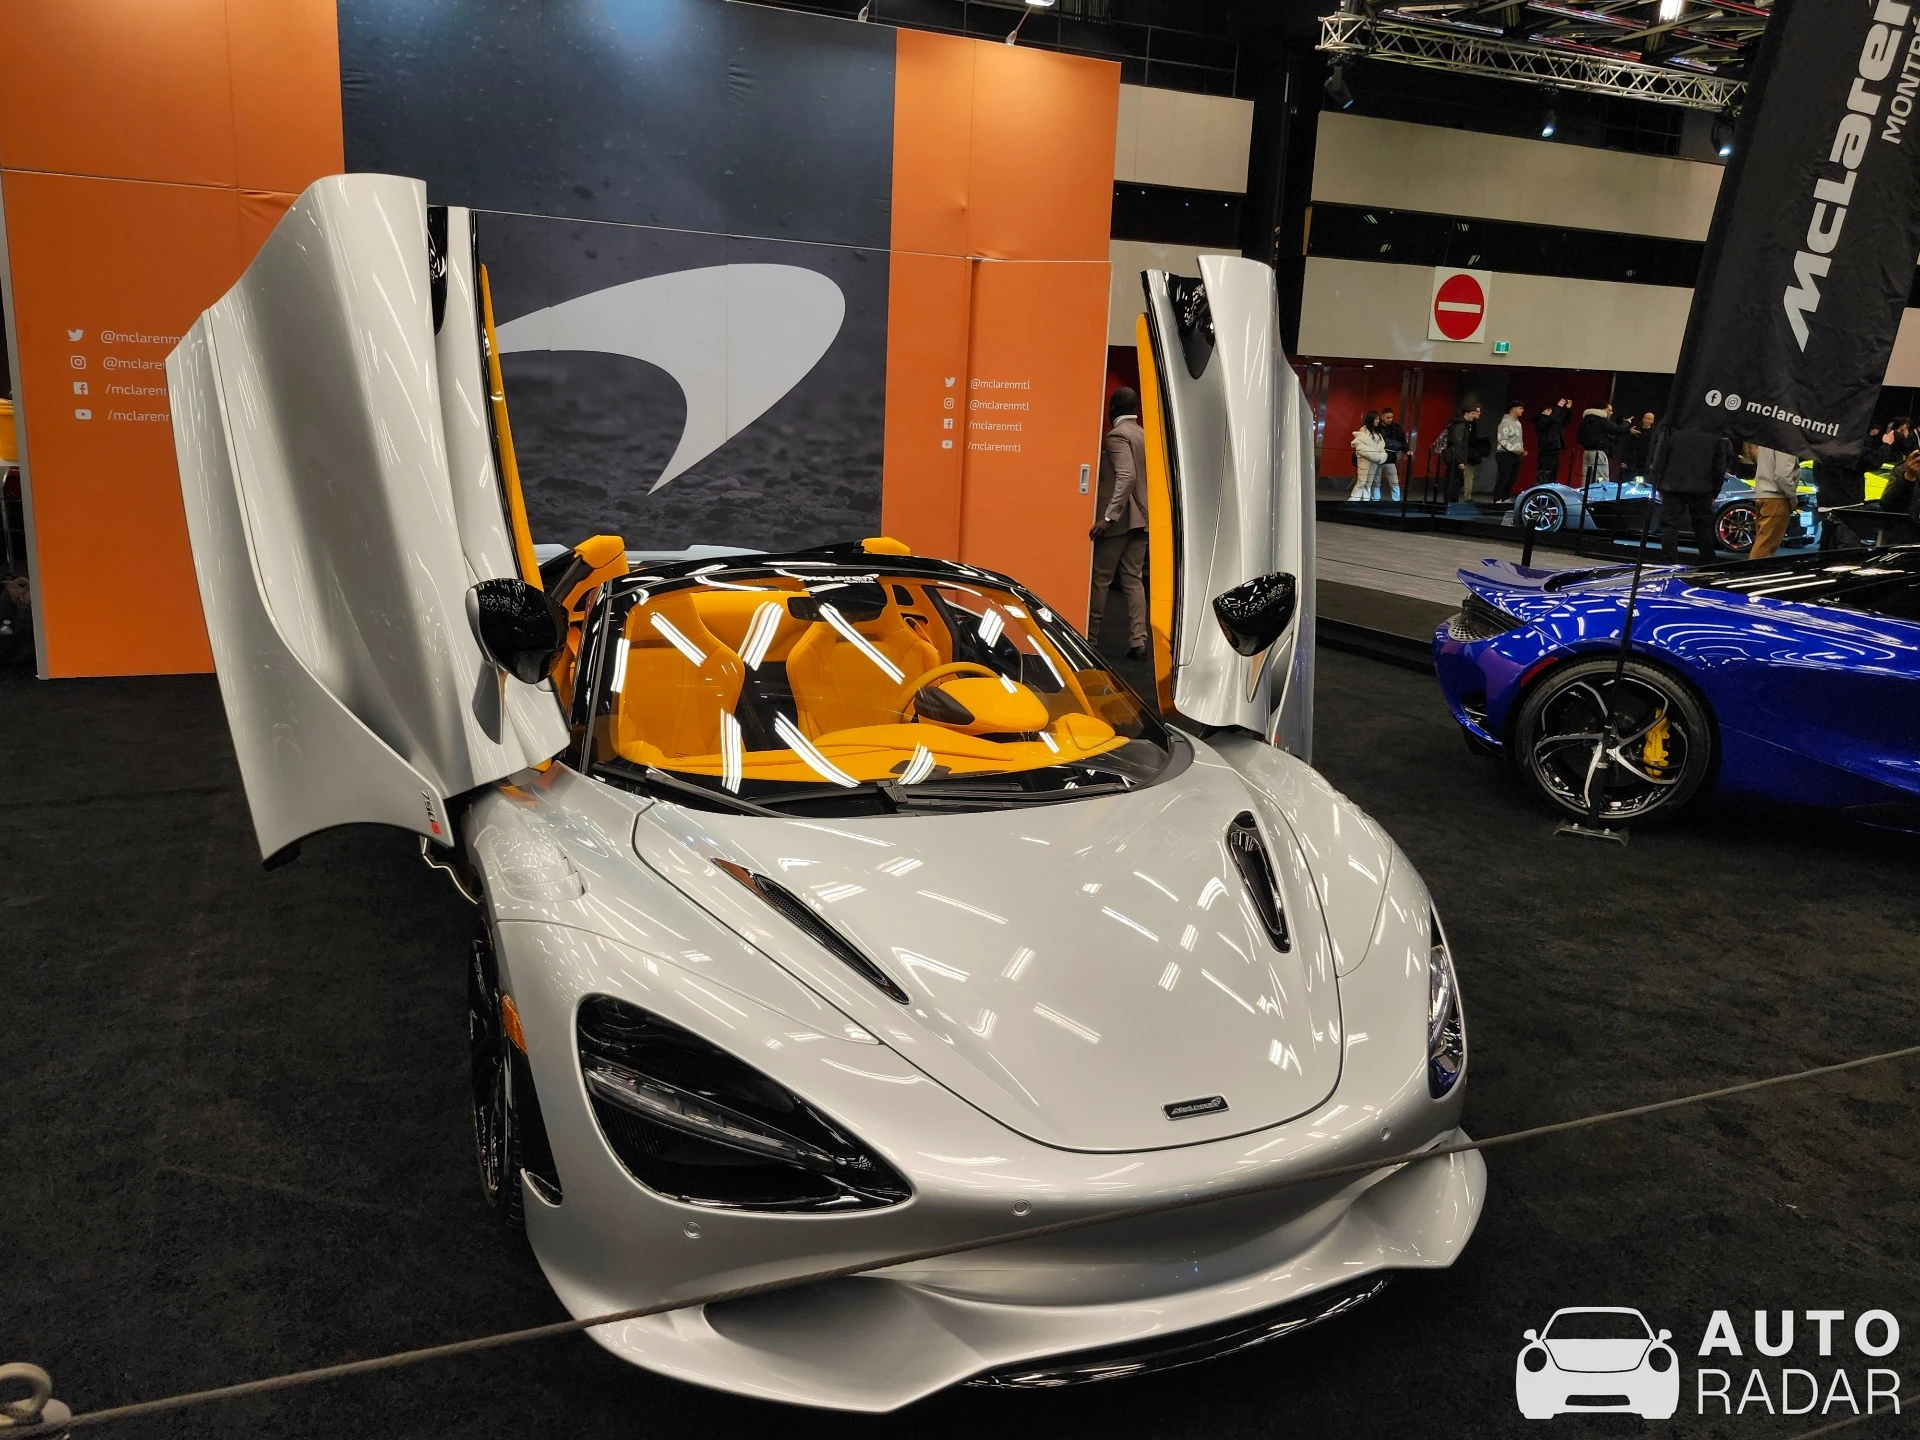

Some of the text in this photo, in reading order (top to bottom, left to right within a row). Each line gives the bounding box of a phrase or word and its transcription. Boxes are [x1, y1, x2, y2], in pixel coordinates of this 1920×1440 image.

[100, 330, 183, 344] @mclarenm
[103, 356, 166, 371] @mclare
[105, 383, 167, 396] /mclaren
[970, 378, 1031, 390] @mclarenmtl
[969, 399, 1029, 411] @mclarenmtl
[1745, 399, 1840, 437] mclarenmtl
[968, 420, 1022, 432] /mclarenmtl
[967, 441, 1021, 453] /mclarenmtl
